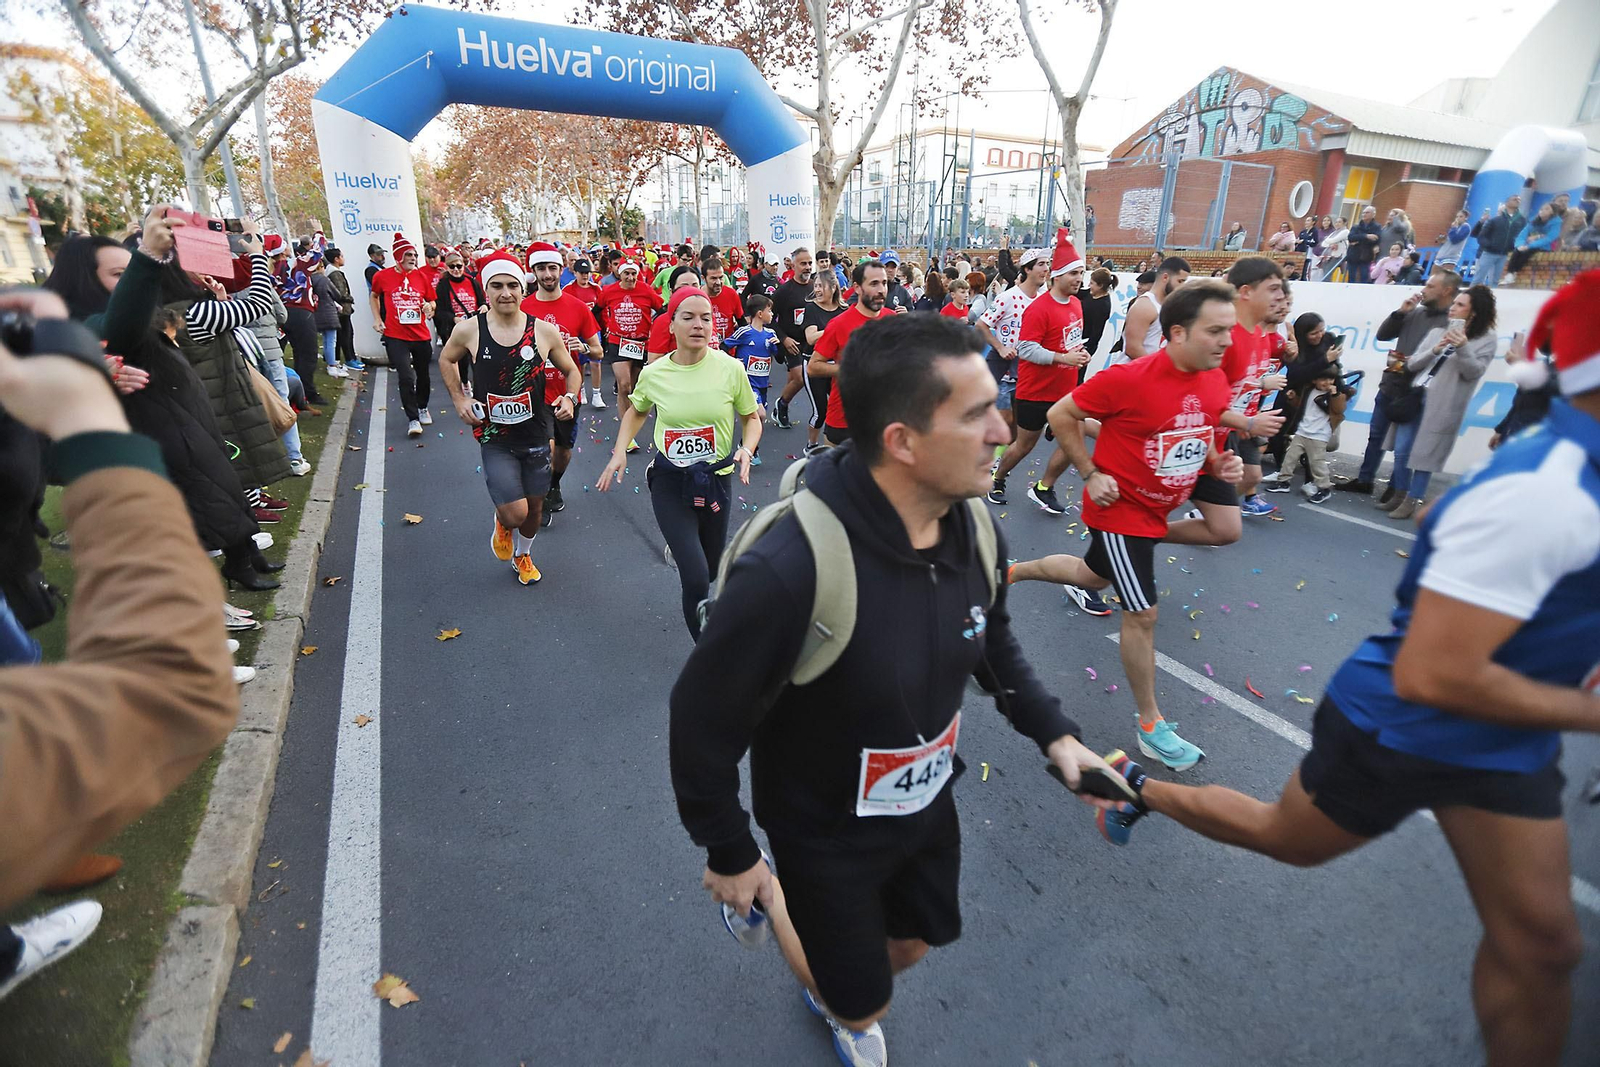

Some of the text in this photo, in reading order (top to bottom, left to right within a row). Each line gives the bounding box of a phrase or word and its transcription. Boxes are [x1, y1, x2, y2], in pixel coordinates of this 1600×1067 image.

[604, 49, 717, 95] original
[334, 171, 401, 190] Huelva
[769, 193, 811, 207] Huelva
[365, 223, 404, 232] HUELVA
[406, 311, 415, 319] 59
[625, 344, 638, 353] 420
[754, 362, 767, 371] 637
[498, 403, 521, 416] 100
[676, 438, 703, 454] 265
[1174, 441, 1202, 461] 464
